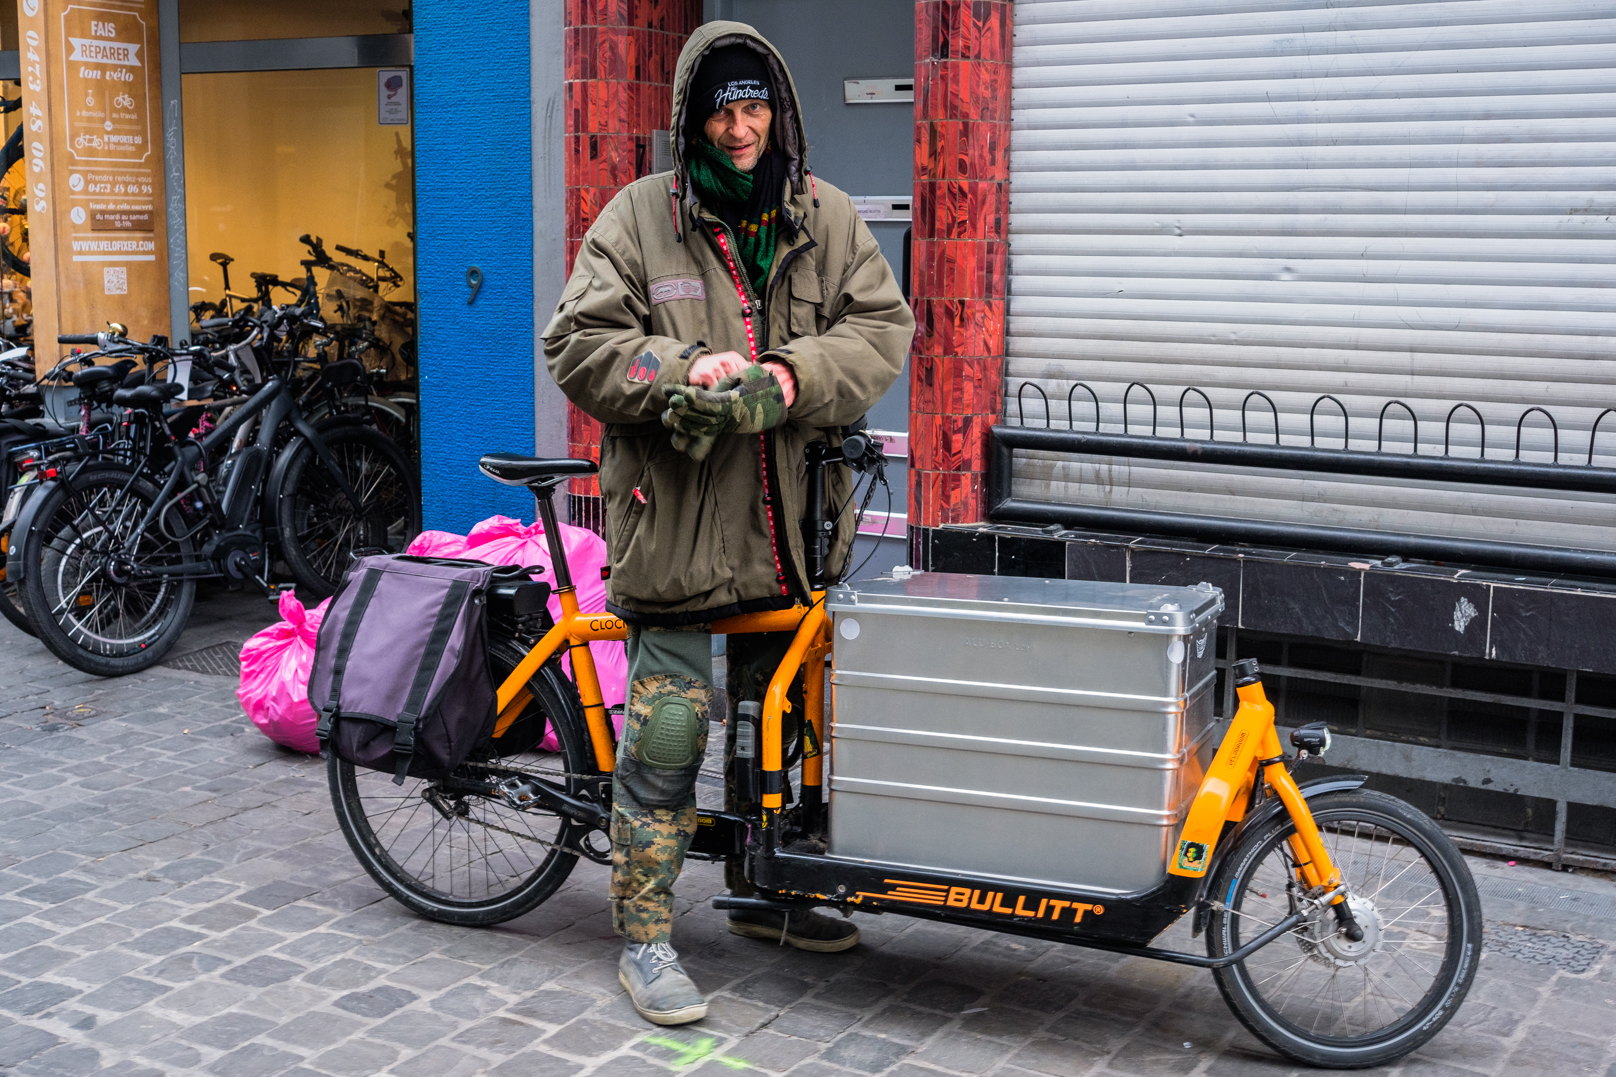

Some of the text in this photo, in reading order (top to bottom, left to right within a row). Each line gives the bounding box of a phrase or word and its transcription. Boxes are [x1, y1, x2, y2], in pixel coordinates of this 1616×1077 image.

[91, 21, 116, 37] FAIS
[80, 41, 130, 62] RÉPARER
[79, 66, 134, 82] ton vélo
[714, 86, 769, 109] Hundreds
[26, 30, 47, 214] 0473 48 06 98
[81, 110, 105, 118] domicile
[103, 134, 134, 144] N'IMPORTE
[109, 143, 136, 151] Bruxelles
[636, 144, 646, 174] 7
[88, 173, 152, 183] Prendre rendez-vous
[88, 183, 152, 194] 0473 48 06 98
[89, 202, 107, 210] Vente
[108, 202, 116, 210] de
[72, 240, 155, 252] WWW.VELOFIXER.COM
[1234, 840, 1262, 879] MARATHON
[1222, 911, 1230, 957] CHWALBE
